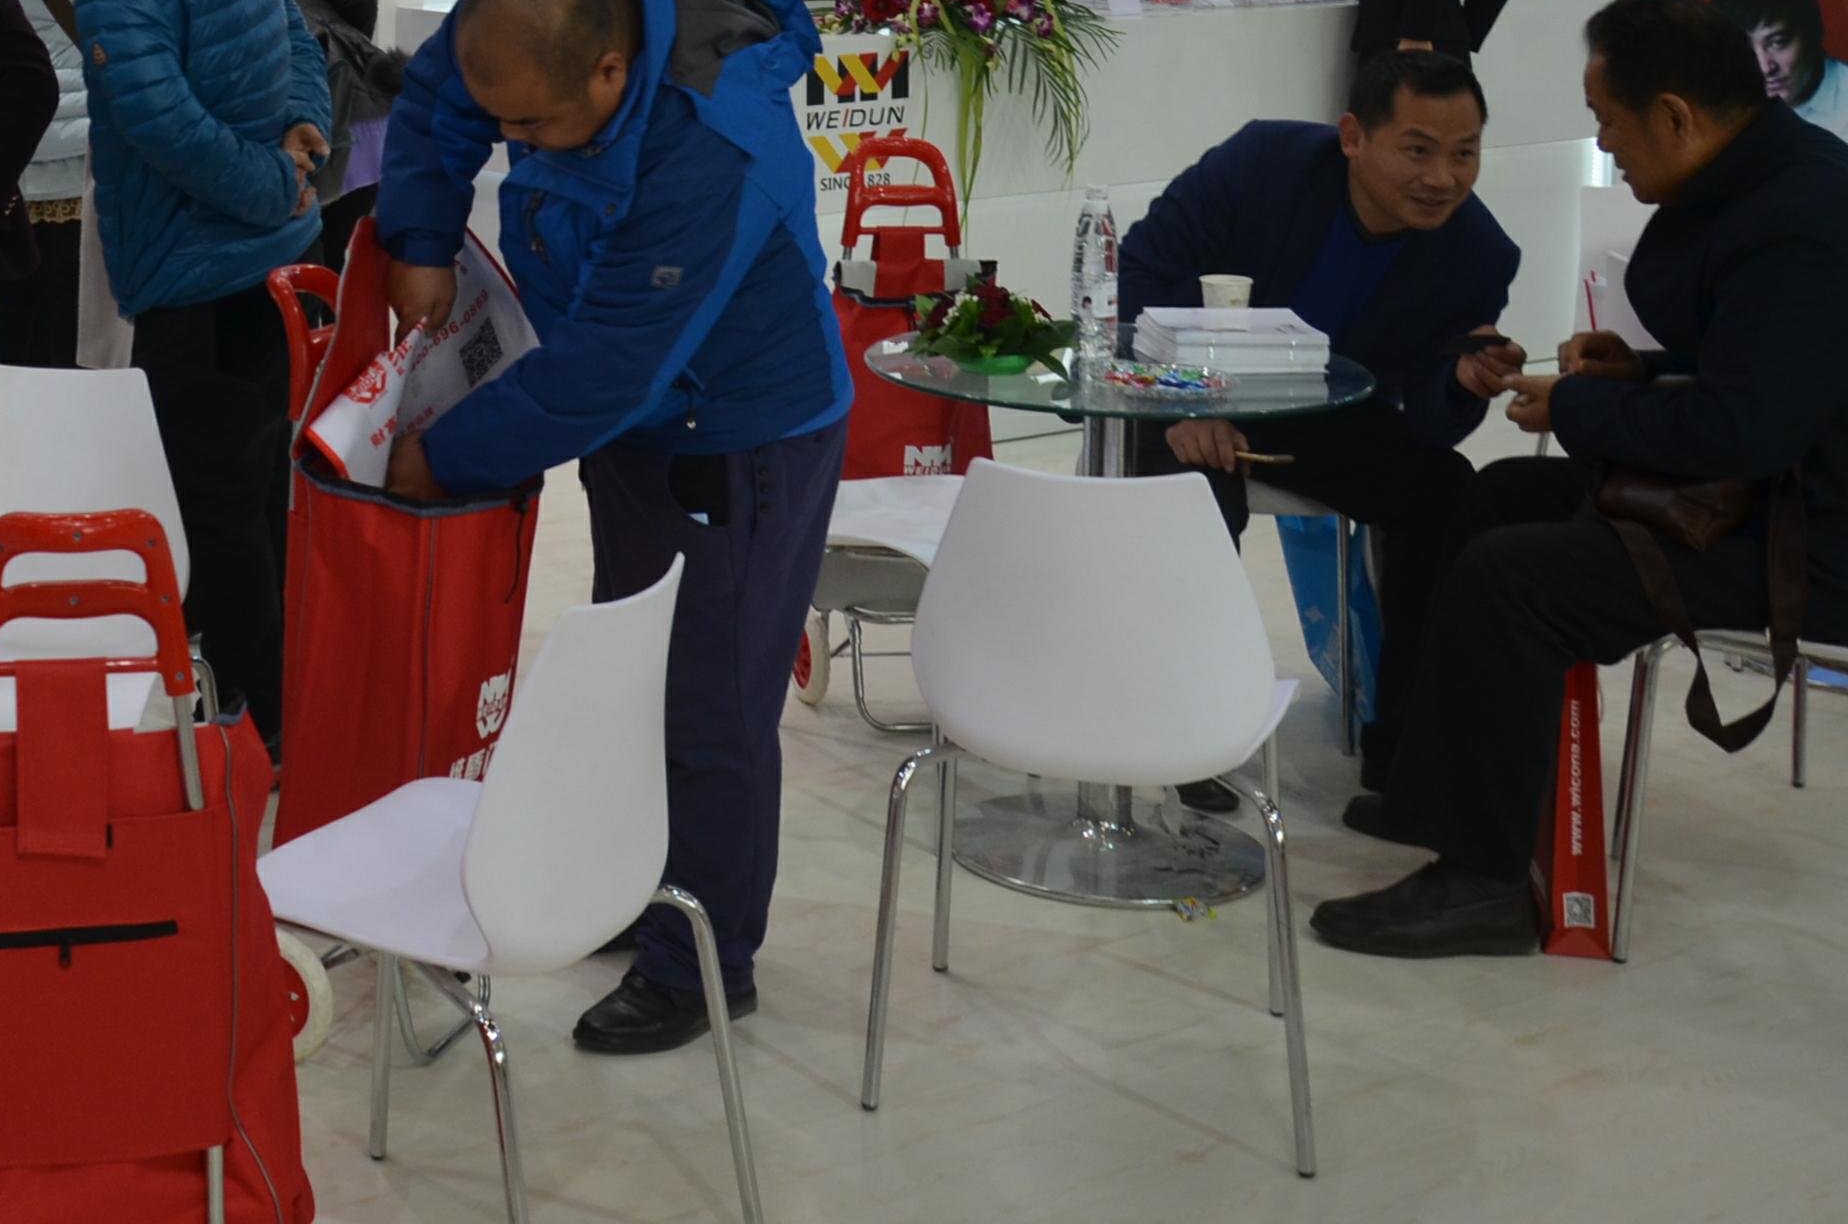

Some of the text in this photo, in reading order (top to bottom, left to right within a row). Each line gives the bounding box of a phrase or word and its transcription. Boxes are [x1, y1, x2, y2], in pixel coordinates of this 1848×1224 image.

[806, 105, 905, 130] WEIDUN
[820, 176, 851, 192] SINC
[1570, 698, 1582, 857] www.wicona.com
